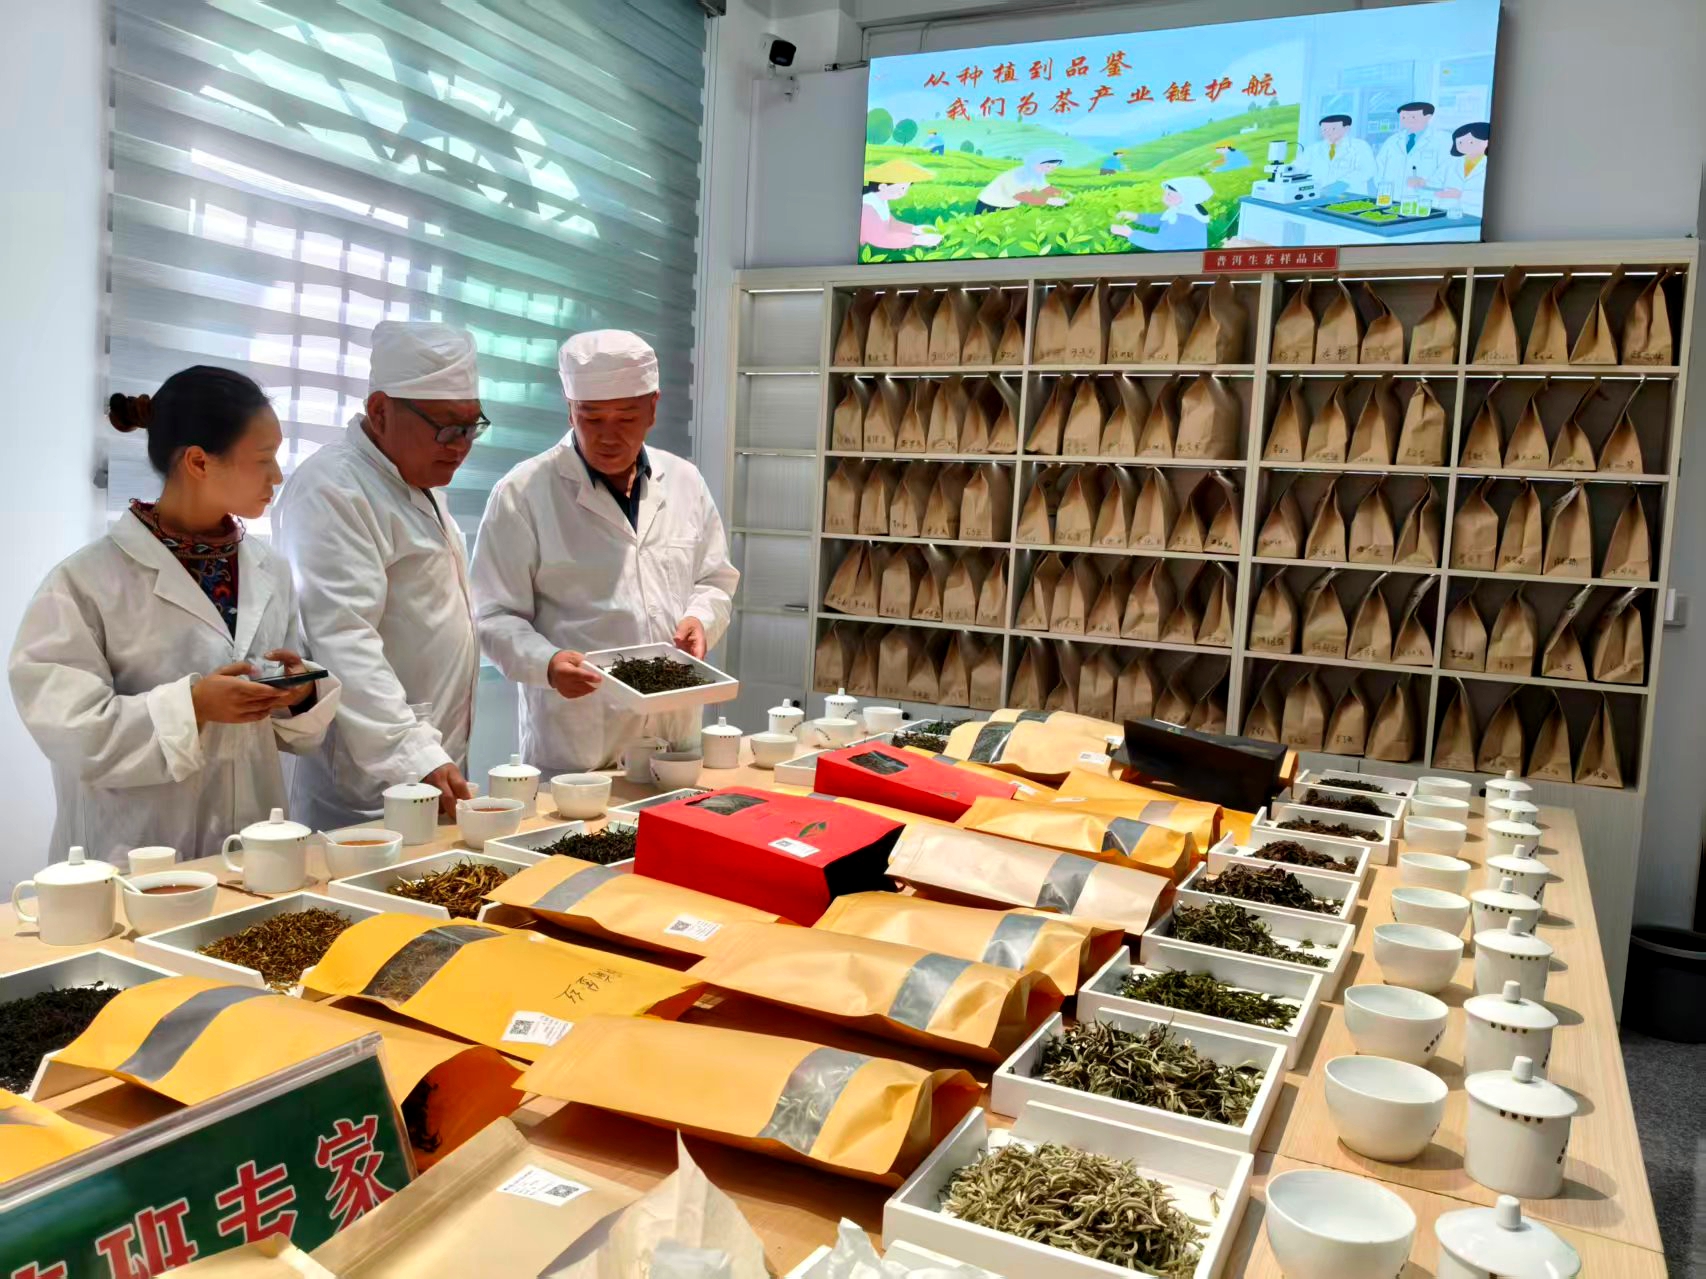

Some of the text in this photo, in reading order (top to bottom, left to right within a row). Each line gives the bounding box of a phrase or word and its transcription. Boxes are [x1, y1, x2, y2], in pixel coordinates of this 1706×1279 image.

[924, 50, 1132, 88] 从种植到品鉴
[946, 73, 1277, 121] 我们为茶产业链护航
[1217, 252, 1324, 267] 普洱生茶样品区
[11, 1115, 396, 1279] 班专家
